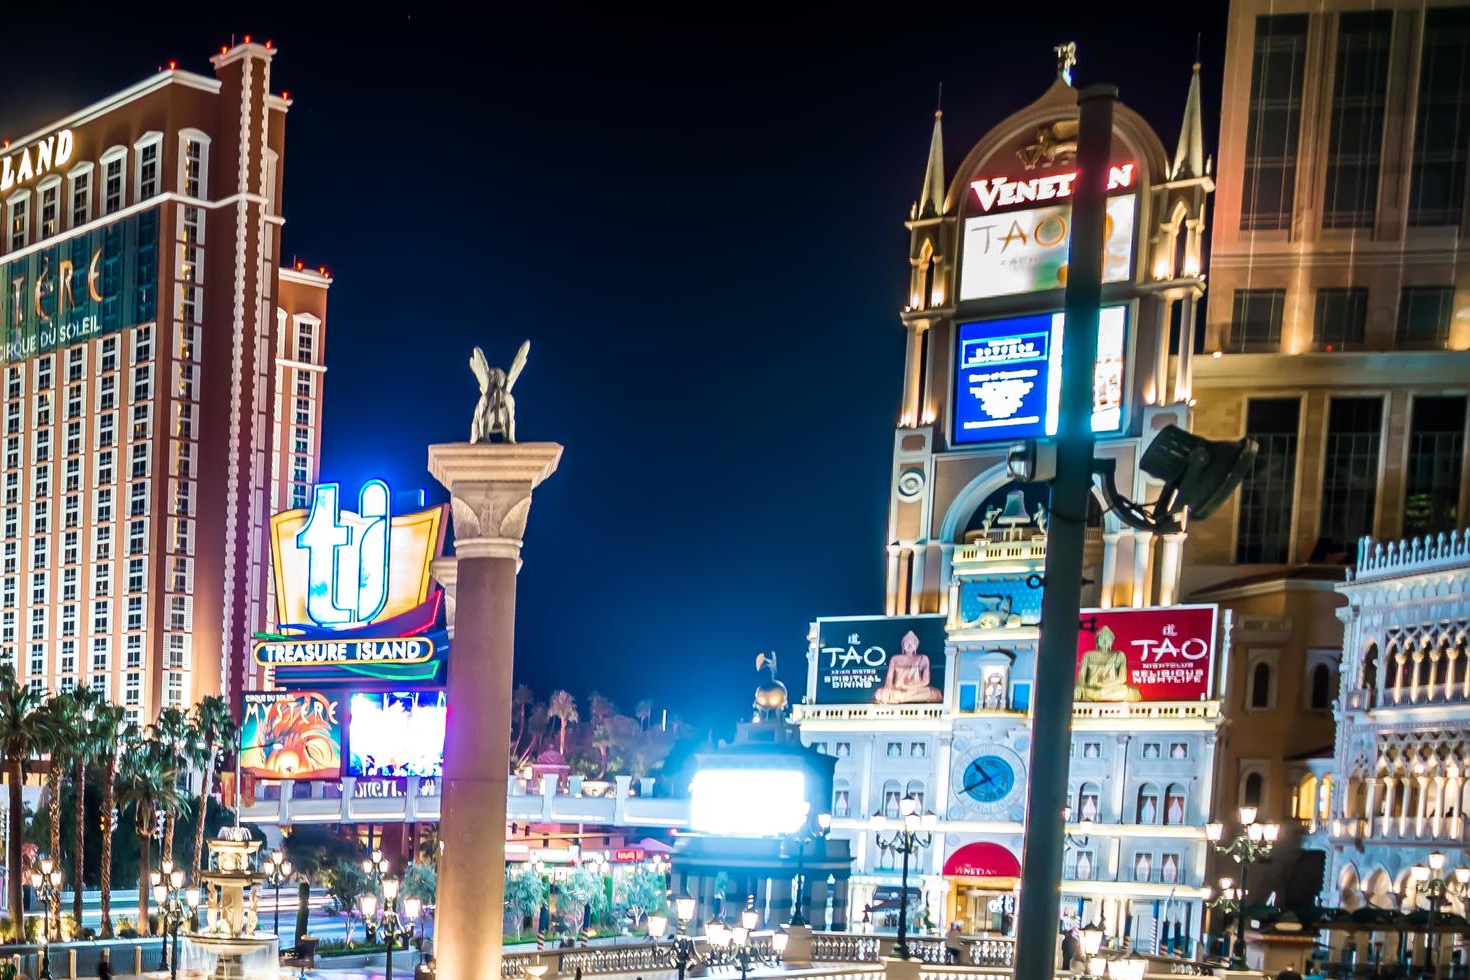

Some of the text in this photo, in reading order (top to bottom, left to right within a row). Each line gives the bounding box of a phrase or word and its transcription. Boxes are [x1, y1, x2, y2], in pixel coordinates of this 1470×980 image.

[970, 164, 1134, 211] VENETN
[971, 214, 1068, 255] TAO
[40, 326, 56, 346] DU
[59, 315, 101, 341] SOLEIL
[266, 640, 421, 662] TREASURE ISLAND
[821, 645, 886, 668] TAO
[1130, 637, 1208, 662] TAO
[824, 674, 882, 684] SPIRITUAL
[1132, 668, 1204, 678] RELIGIOUS
[1132, 676, 1202, 684] NIGHTLIFE
[832, 681, 872, 689] DINING
